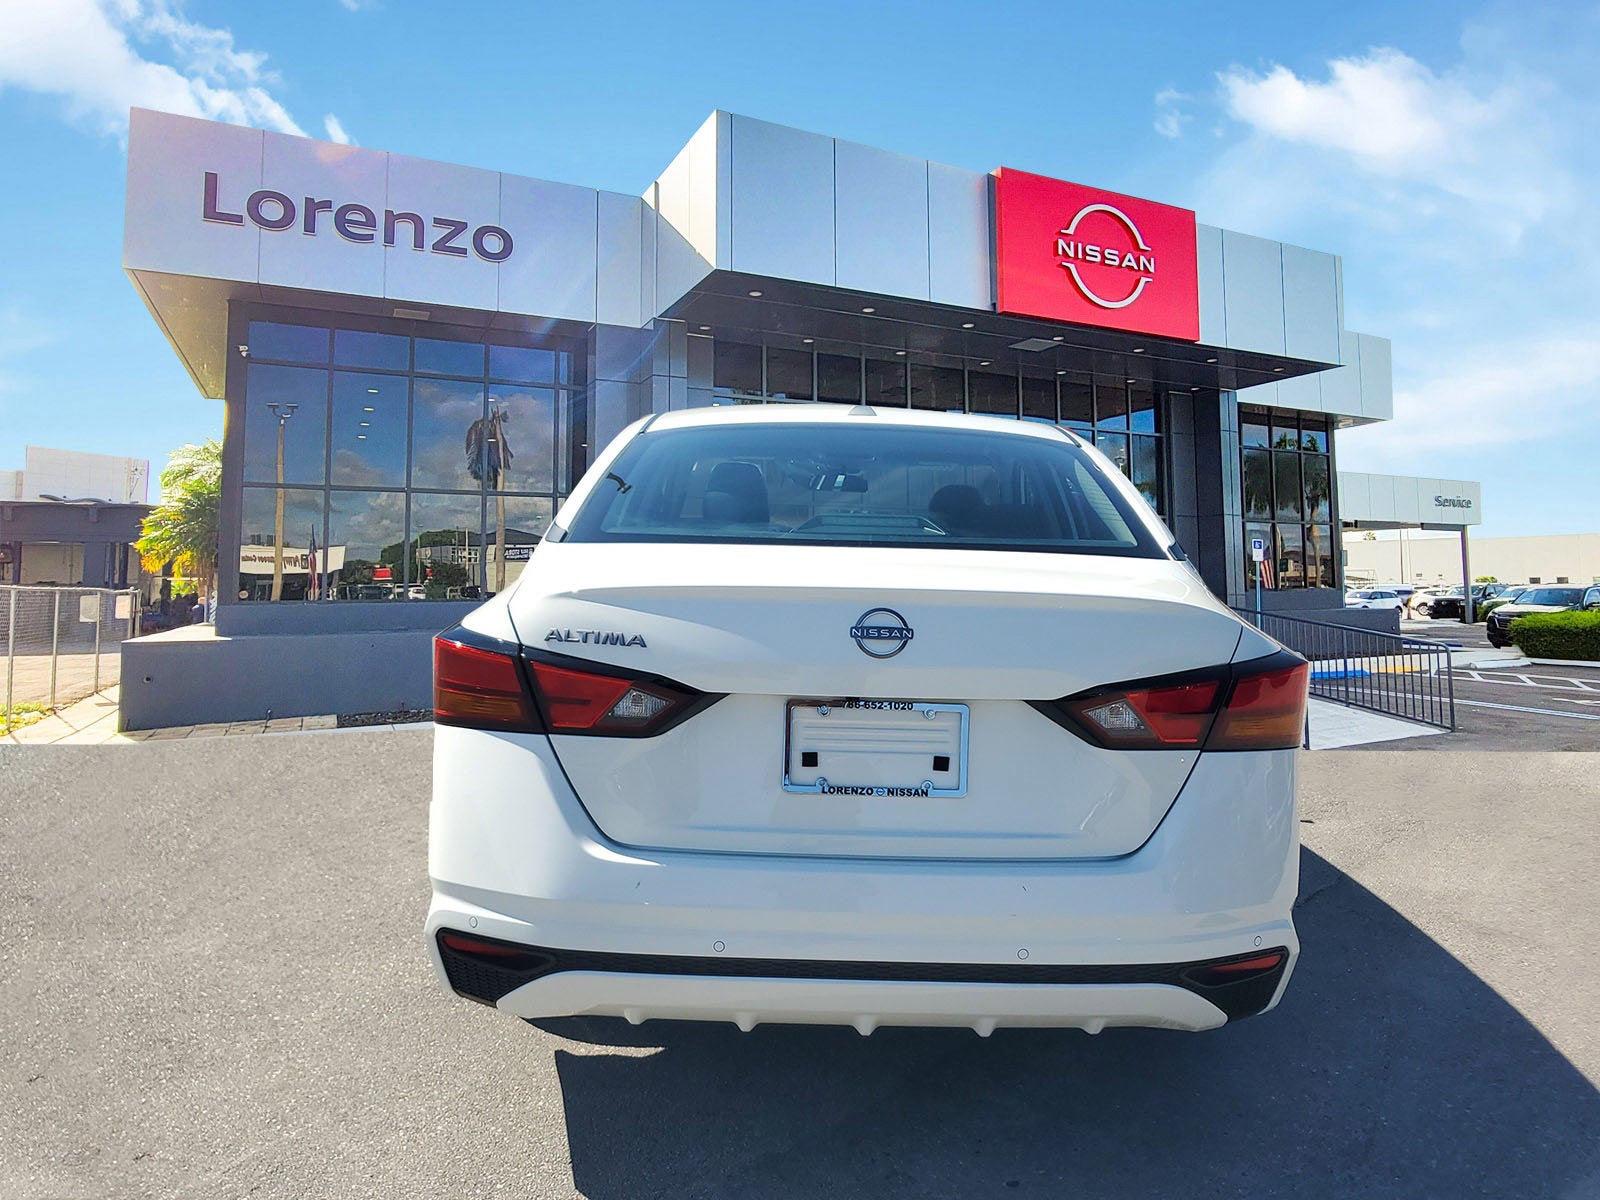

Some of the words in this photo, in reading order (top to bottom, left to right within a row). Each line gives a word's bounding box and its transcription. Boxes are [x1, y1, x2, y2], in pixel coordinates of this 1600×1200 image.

[201, 171, 515, 263] Lorenzo
[1057, 238, 1155, 273] NISSAN
[1434, 495, 1472, 508] Service
[544, 627, 648, 648] ALTIMA
[851, 627, 913, 641] NISSAN
[842, 701, 914, 710] 786-652-1020
[821, 786, 874, 796] LORENZO
[887, 787, 929, 797] NISSAN
